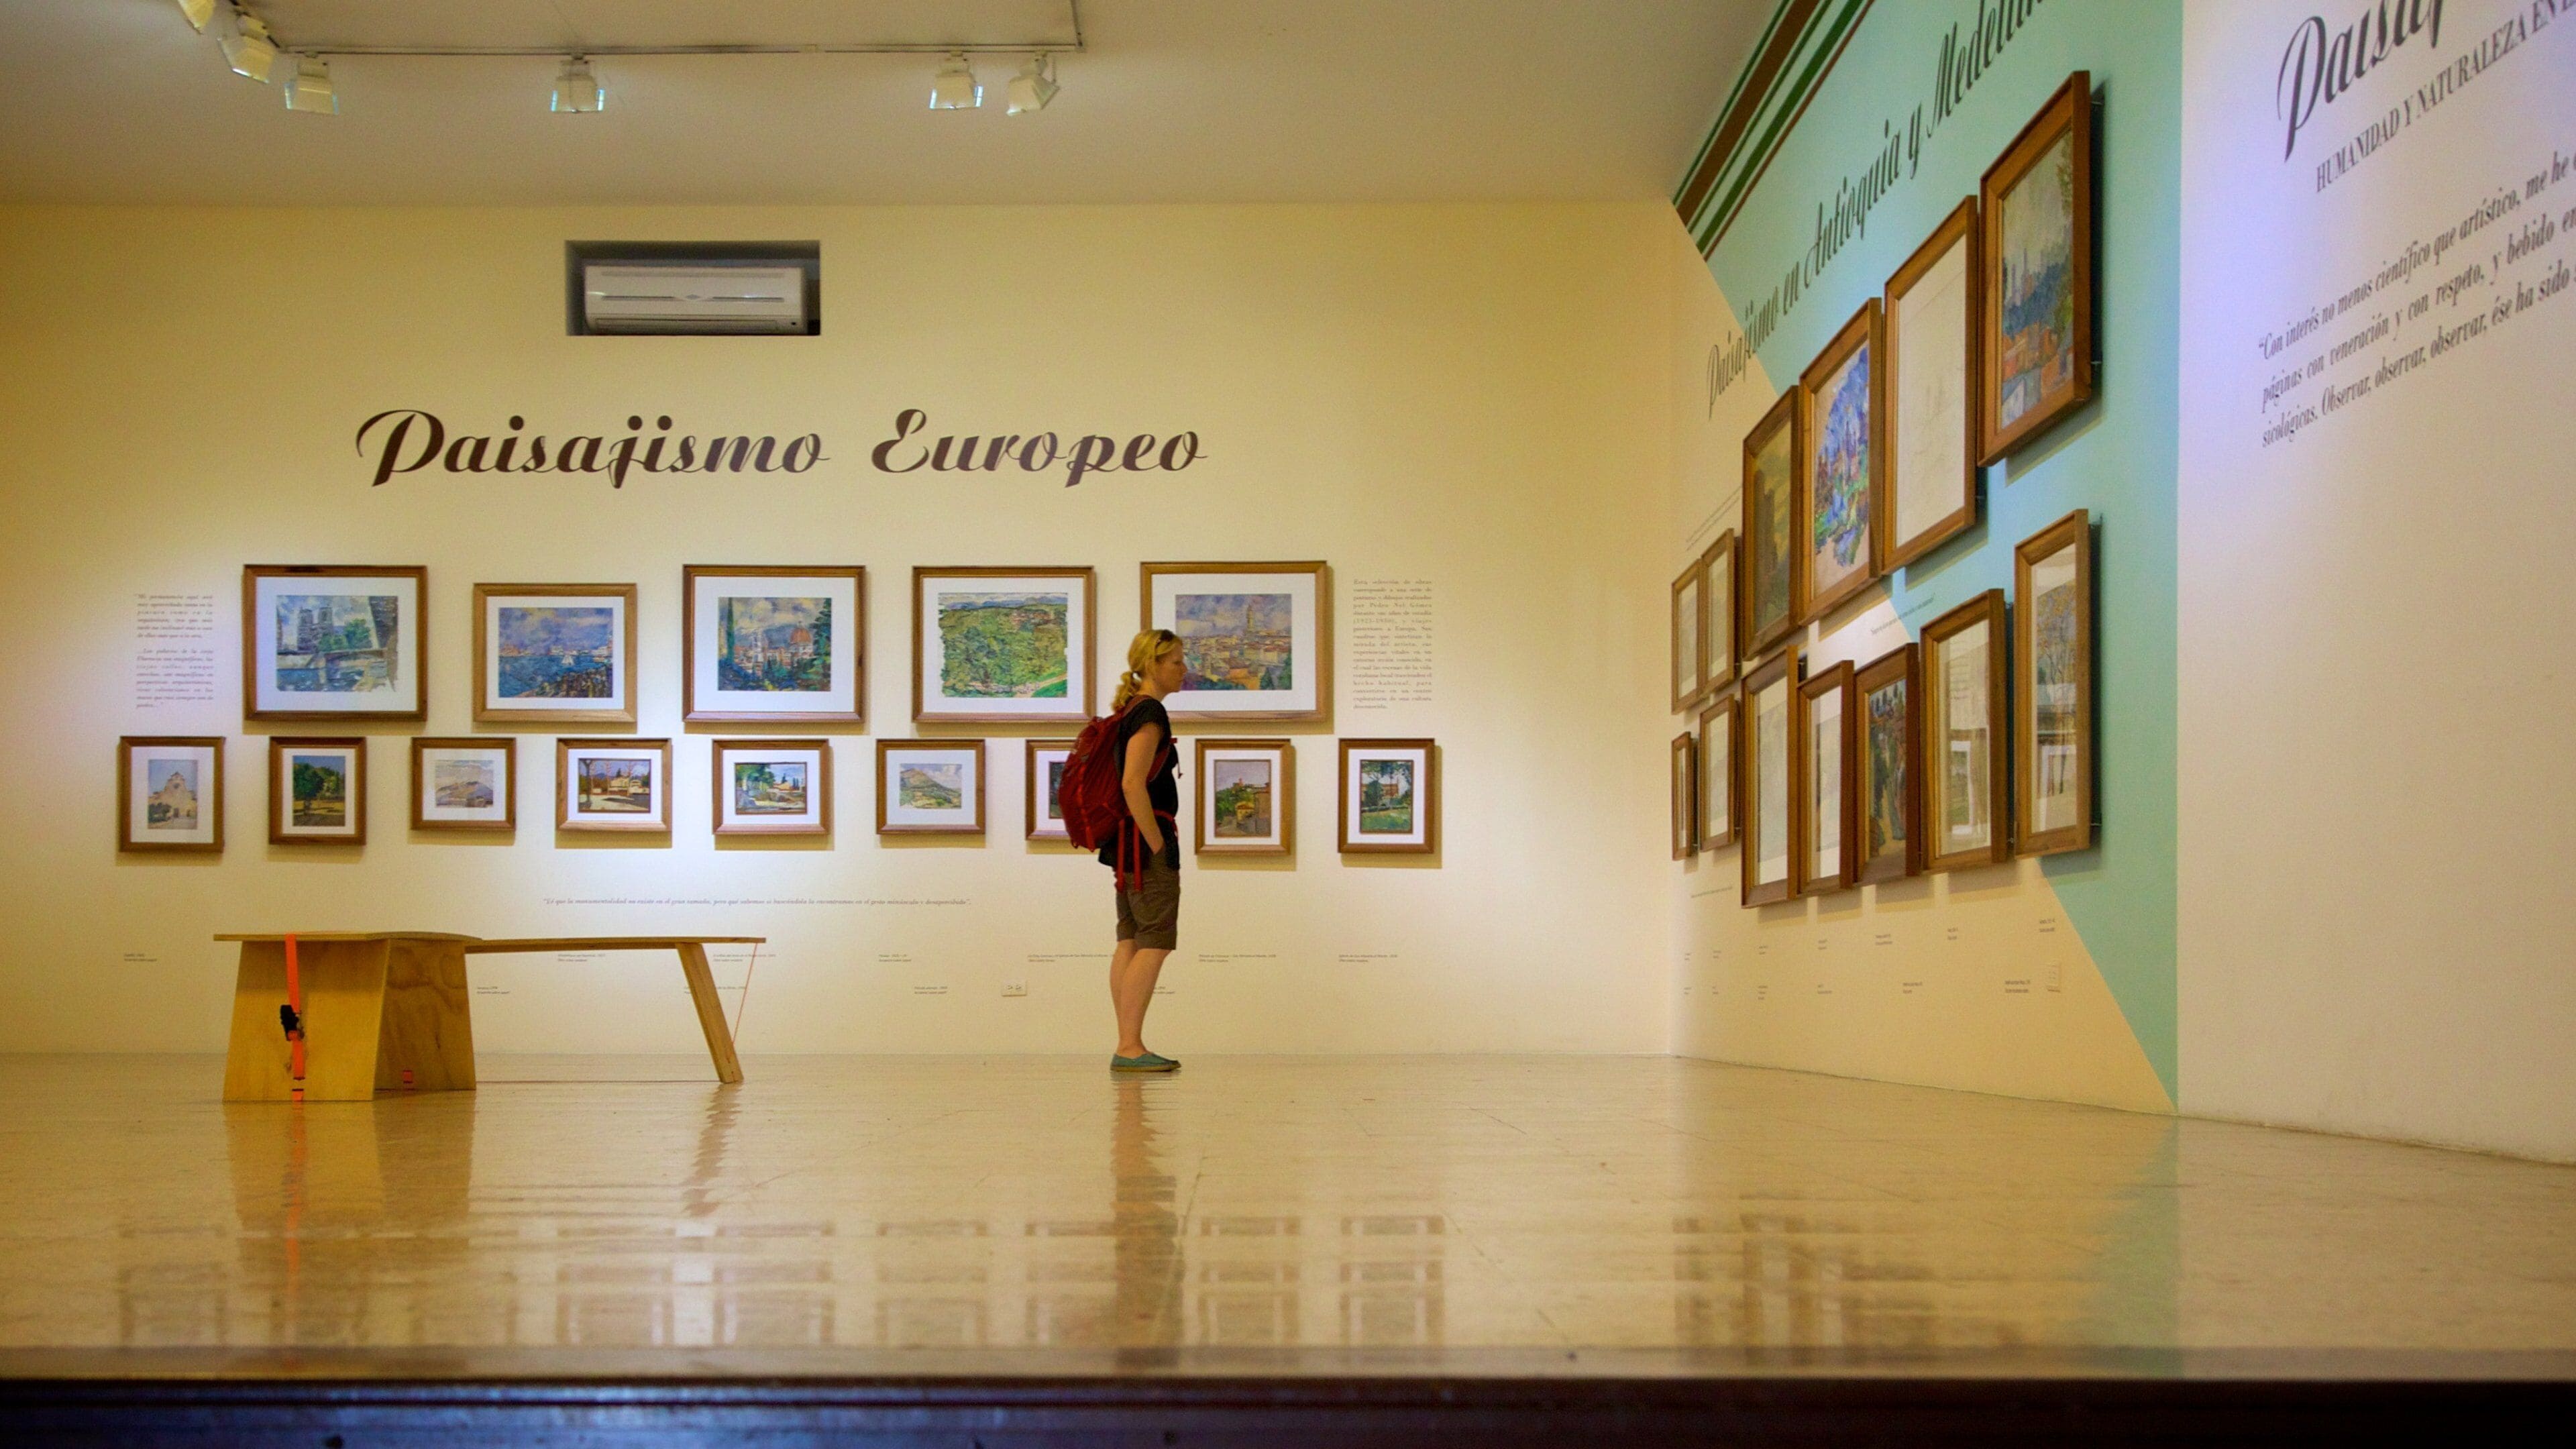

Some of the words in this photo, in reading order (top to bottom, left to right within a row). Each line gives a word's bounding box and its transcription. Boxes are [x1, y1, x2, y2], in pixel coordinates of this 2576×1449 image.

[2316, 107, 2400, 193] HUMANIDAD
[2403, 95, 2414, 128] Y
[2416, 13, 2527, 119] NATURALEZA
[1707, 284, 1779, 421] Paisajismo
[1783, 260, 1801, 317] en
[1804, 118, 1901, 289] Antioquia
[1907, 99, 1923, 180] y
[2262, 368, 2302, 414] páginas
[2307, 356, 2324, 378] con
[2330, 311, 2389, 366] veneración
[2393, 309, 2403, 341] y
[2408, 294, 2428, 321] con
[2436, 264, 2484, 307] respeto,
[2489, 251, 2502, 286] y
[2507, 213, 2555, 264] bebido
[2286, 307, 2319, 347] interés
[2322, 303, 2335, 325] no
[2338, 280, 2373, 315] menos
[2375, 239, 2431, 291] científico
[2434, 227, 2457, 266] que
[2459, 186, 2521, 240] artístico,
[2526, 170, 2548, 200] me
[2551, 151, 2569, 184] he
[356, 409, 832, 489] Paisajismo
[871, 408, 1209, 488] Europeo
[2262, 404, 2318, 447] sicológicas.
[2491, 294, 2513, 326] ése
[2516, 281, 2534, 313] ha
[2539, 258, 2571, 301] sido
